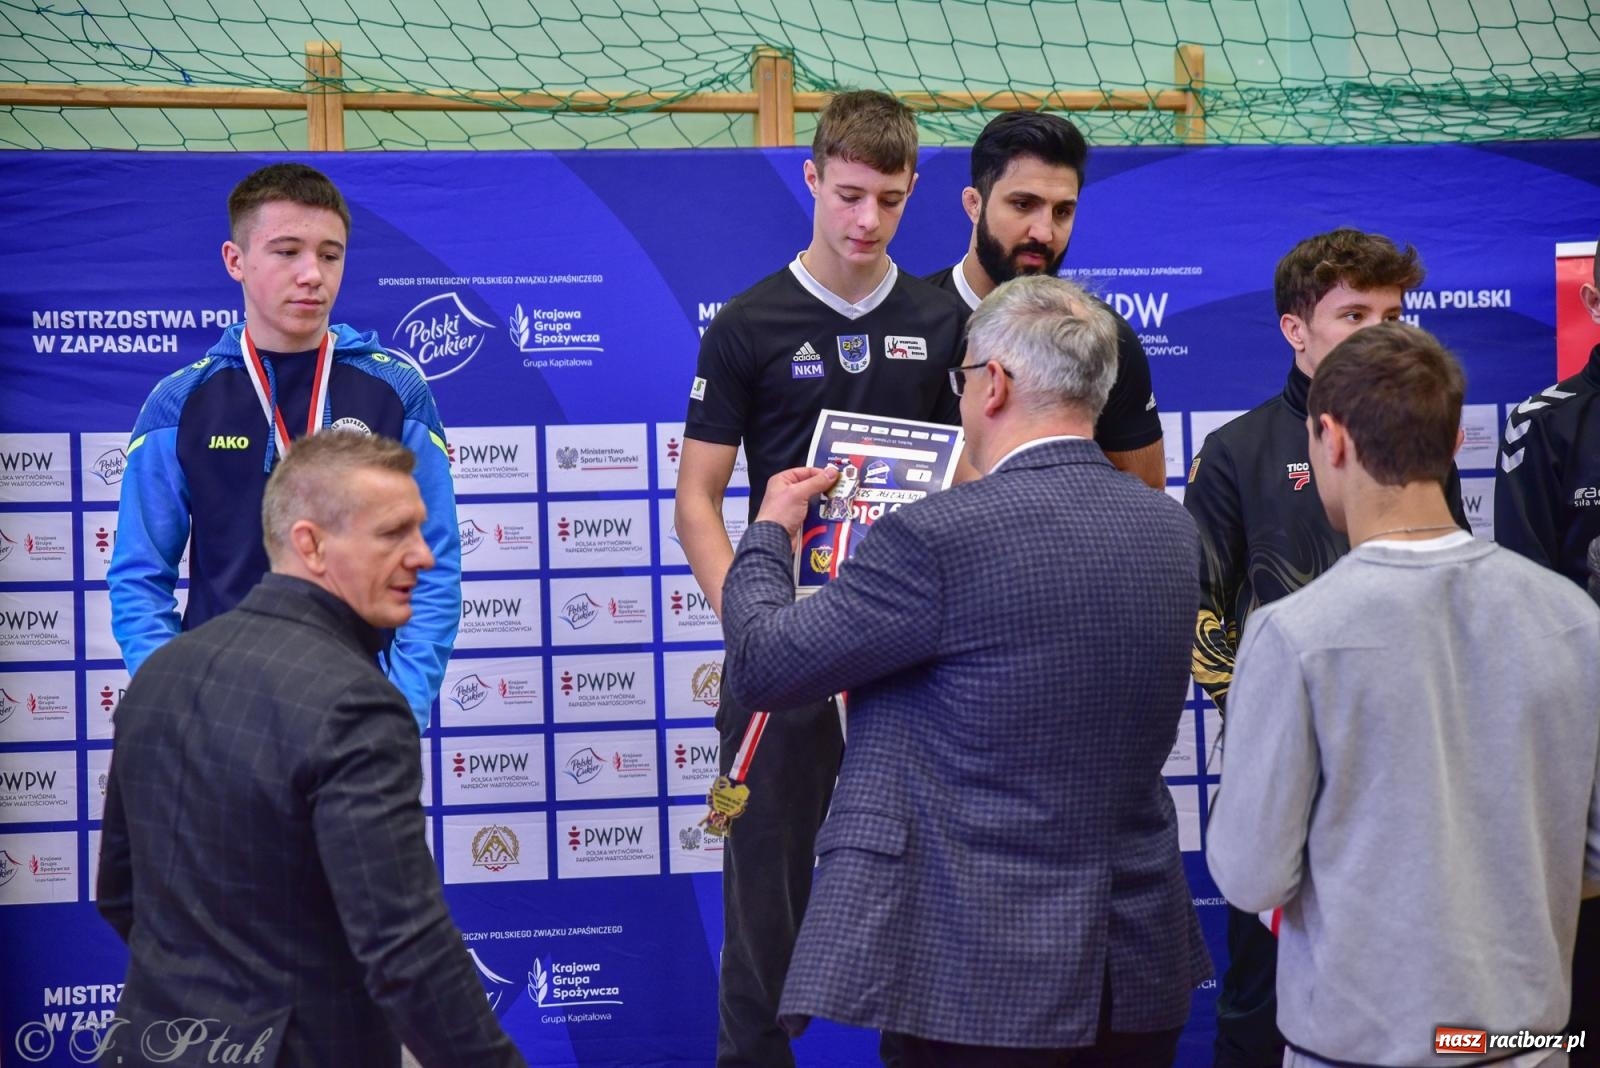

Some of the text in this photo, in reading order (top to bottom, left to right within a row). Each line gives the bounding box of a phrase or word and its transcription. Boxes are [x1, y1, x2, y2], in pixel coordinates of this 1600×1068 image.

[378, 274, 604, 286] SPONSOR STRATEGICZNY POLSKIEGO ZWIĄZKU ZAPAŚNICZEGO
[1440, 289, 1512, 308] POLSKI
[32, 310, 247, 329] MISTRZOSTWA POL
[534, 308, 581, 320] Krajowa
[405, 313, 460, 349] Polski
[534, 320, 572, 332] Grupa
[32, 335, 178, 353] W ZAPASACH
[534, 332, 600, 345] Spożywcza
[418, 334, 477, 364] Cukier
[524, 358, 592, 368] Grupa Kapitałowa
[792, 352, 820, 362] adidas
[794, 364, 822, 376] NKM
[208, 436, 249, 449] JAKO
[460, 444, 518, 464] PWPW
[580, 456, 603, 464] Sportu
[608, 455, 638, 464] Turystyki
[0, 452, 53, 472] WPW
[1286, 462, 1310, 472] TICO
[574, 518, 632, 538] PWPW
[462, 598, 522, 618] PWPW
[577, 672, 635, 692] PWPW
[470, 753, 528, 774] PWPW
[0, 770, 56, 791] WPW
[585, 826, 642, 847] PWPW
[490, 930, 532, 940] POLSKIEGO
[533, 928, 566, 938] ZWIĄZKU
[568, 925, 623, 936] ZAPAŚNICZEGO
[552, 962, 600, 975] Krajowa
[552, 976, 590, 986] Grupa
[552, 986, 619, 1000] Spożywcza
[541, 1012, 612, 1024] Grupa Kapitałowa
